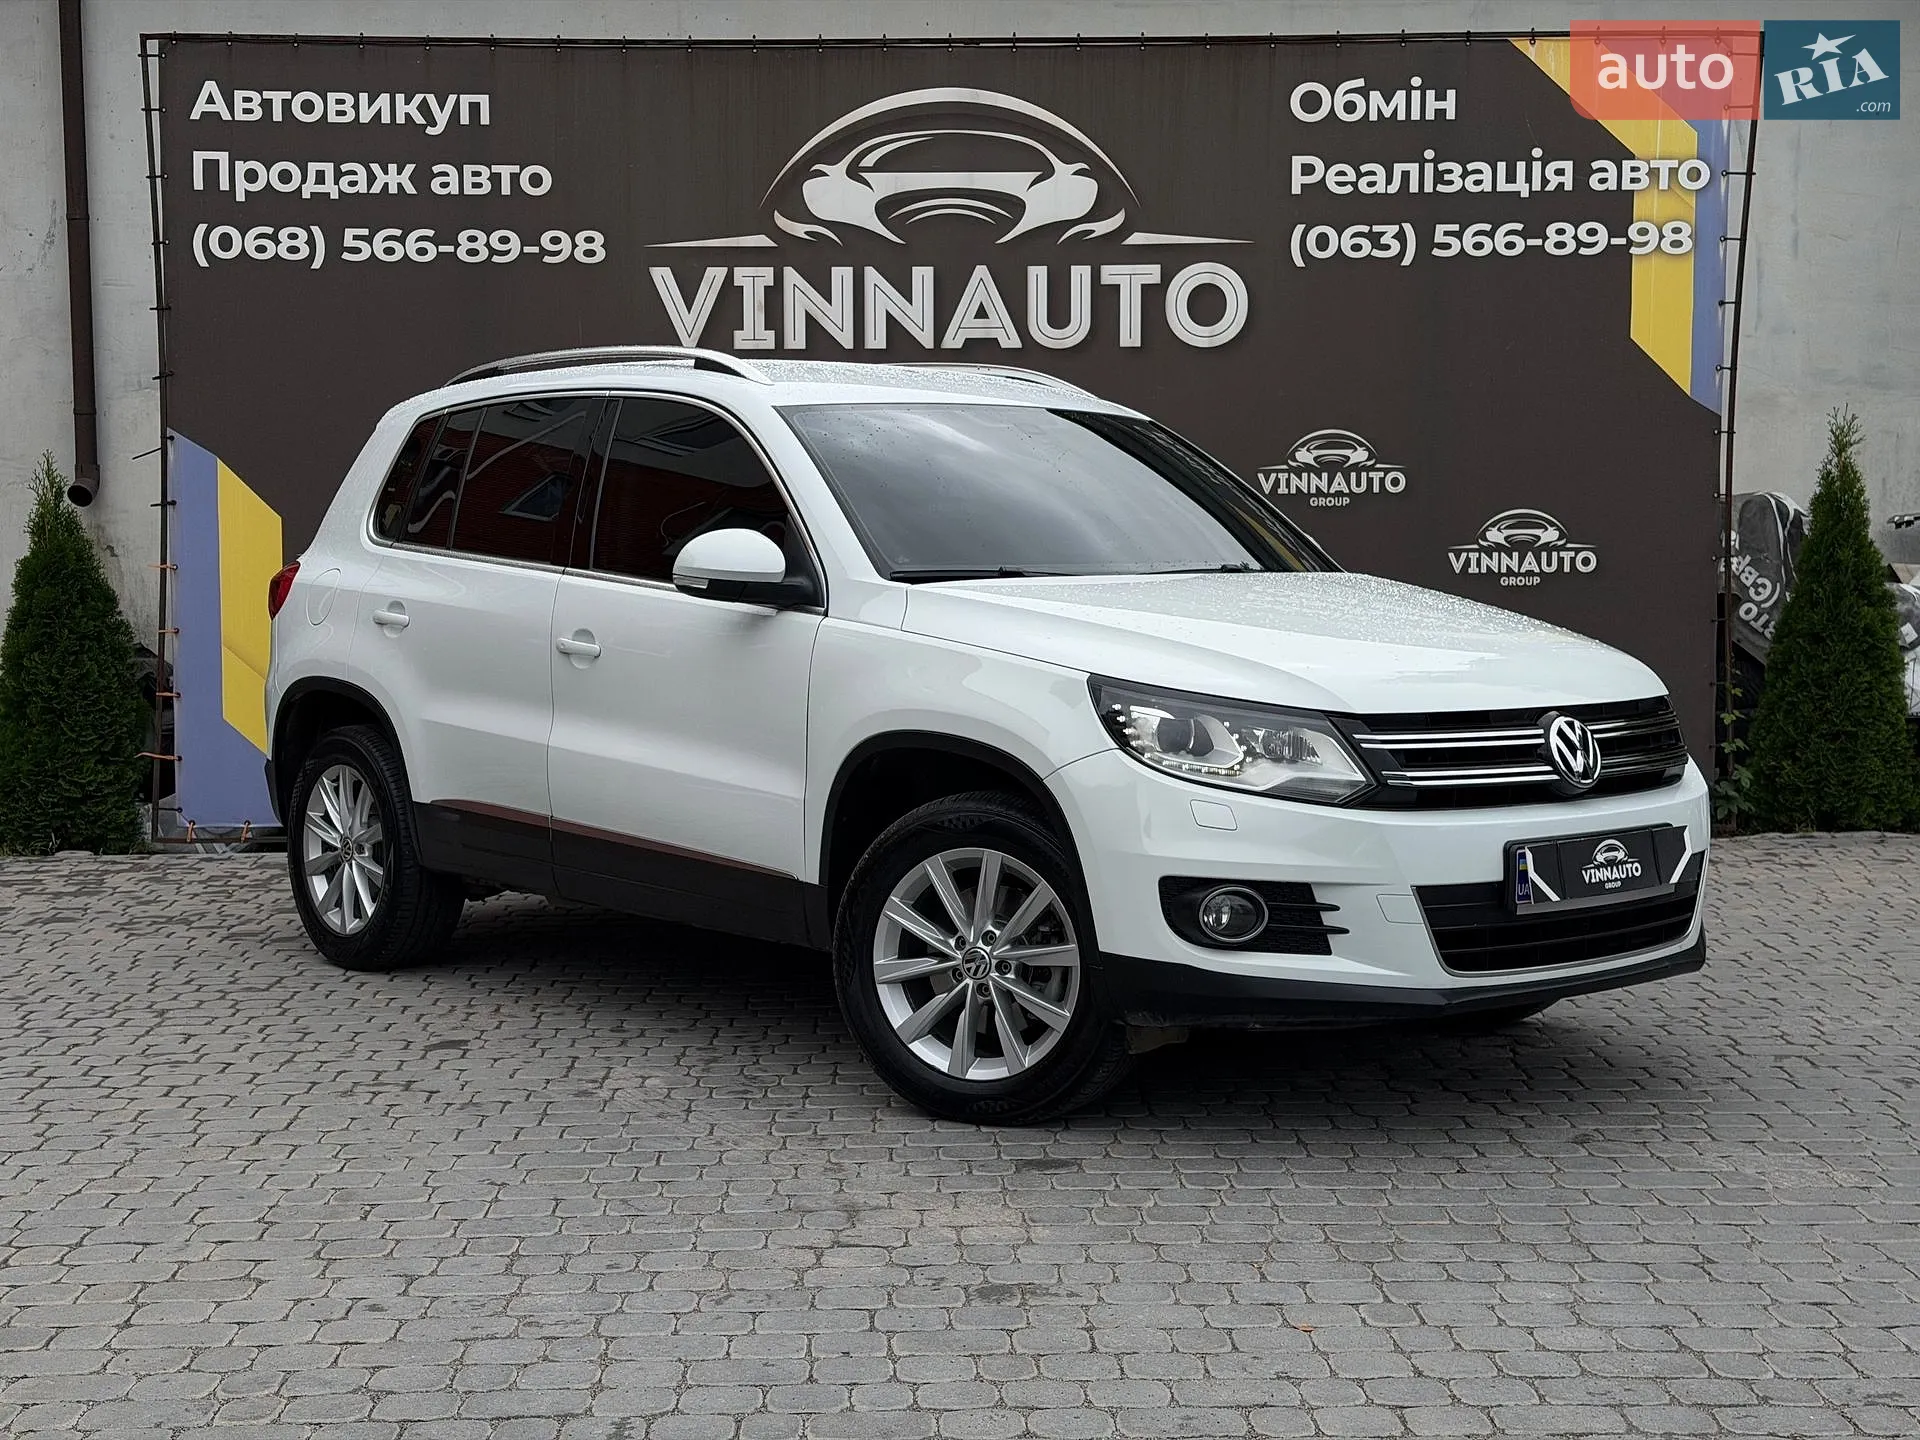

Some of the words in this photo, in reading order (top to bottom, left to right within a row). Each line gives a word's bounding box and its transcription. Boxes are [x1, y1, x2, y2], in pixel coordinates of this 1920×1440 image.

[189, 80, 491, 136] Автовикуп
[1290, 76, 1456, 123] Обмін
[192, 150, 418, 202] Продаж
[430, 163, 553, 196] авто
[1290, 147, 1574, 198] Реалізація
[1588, 158, 1711, 192] авто
[192, 223, 327, 269] (068)
[341, 228, 606, 264] 566-89-98
[1290, 222, 1417, 267] (063)
[1431, 220, 1694, 256] 566-89-98
[648, 261, 1250, 350] VINNAUTO
[1257, 471, 1407, 495] VINNAUTO
[1309, 496, 1350, 507] GROUP
[1447, 550, 1598, 574] VINNAUTO
[1500, 576, 1541, 586] GROUP
[1518, 883, 1530, 896] UA
[1581, 862, 1642, 885] VINNAUTO
[1604, 880, 1622, 890] GROUP
